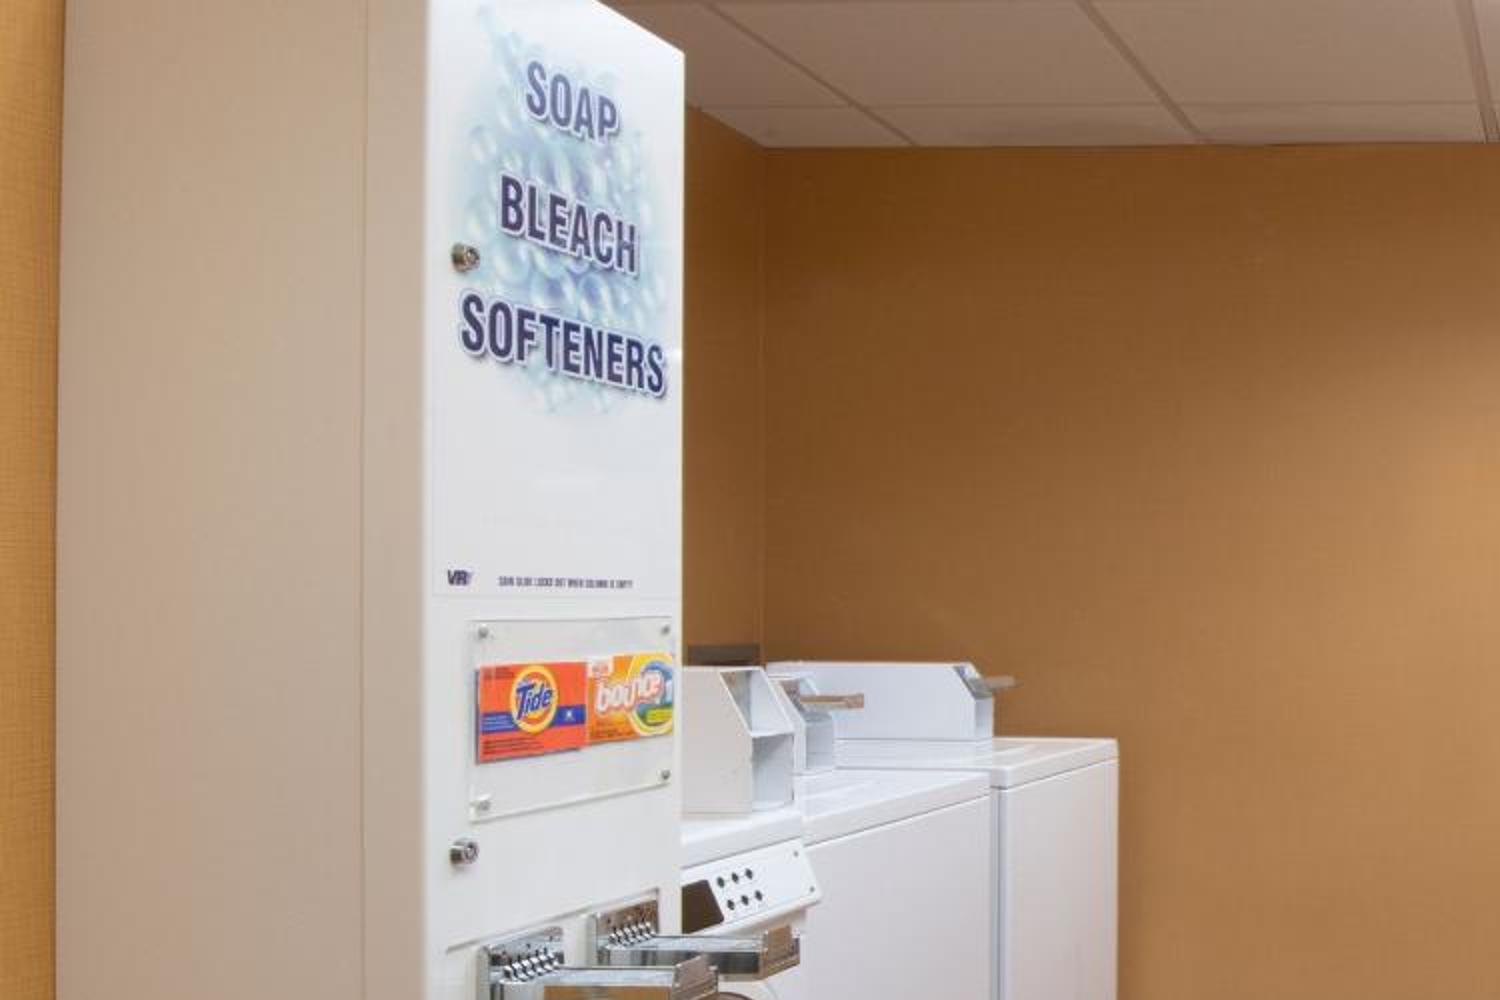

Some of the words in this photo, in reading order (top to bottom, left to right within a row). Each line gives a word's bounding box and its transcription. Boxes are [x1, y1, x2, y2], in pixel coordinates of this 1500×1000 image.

[525, 60, 618, 141] SOAP
[499, 174, 638, 275] BLEACH
[461, 293, 666, 396] SOFTENERS
[516, 680, 554, 721] Tide
